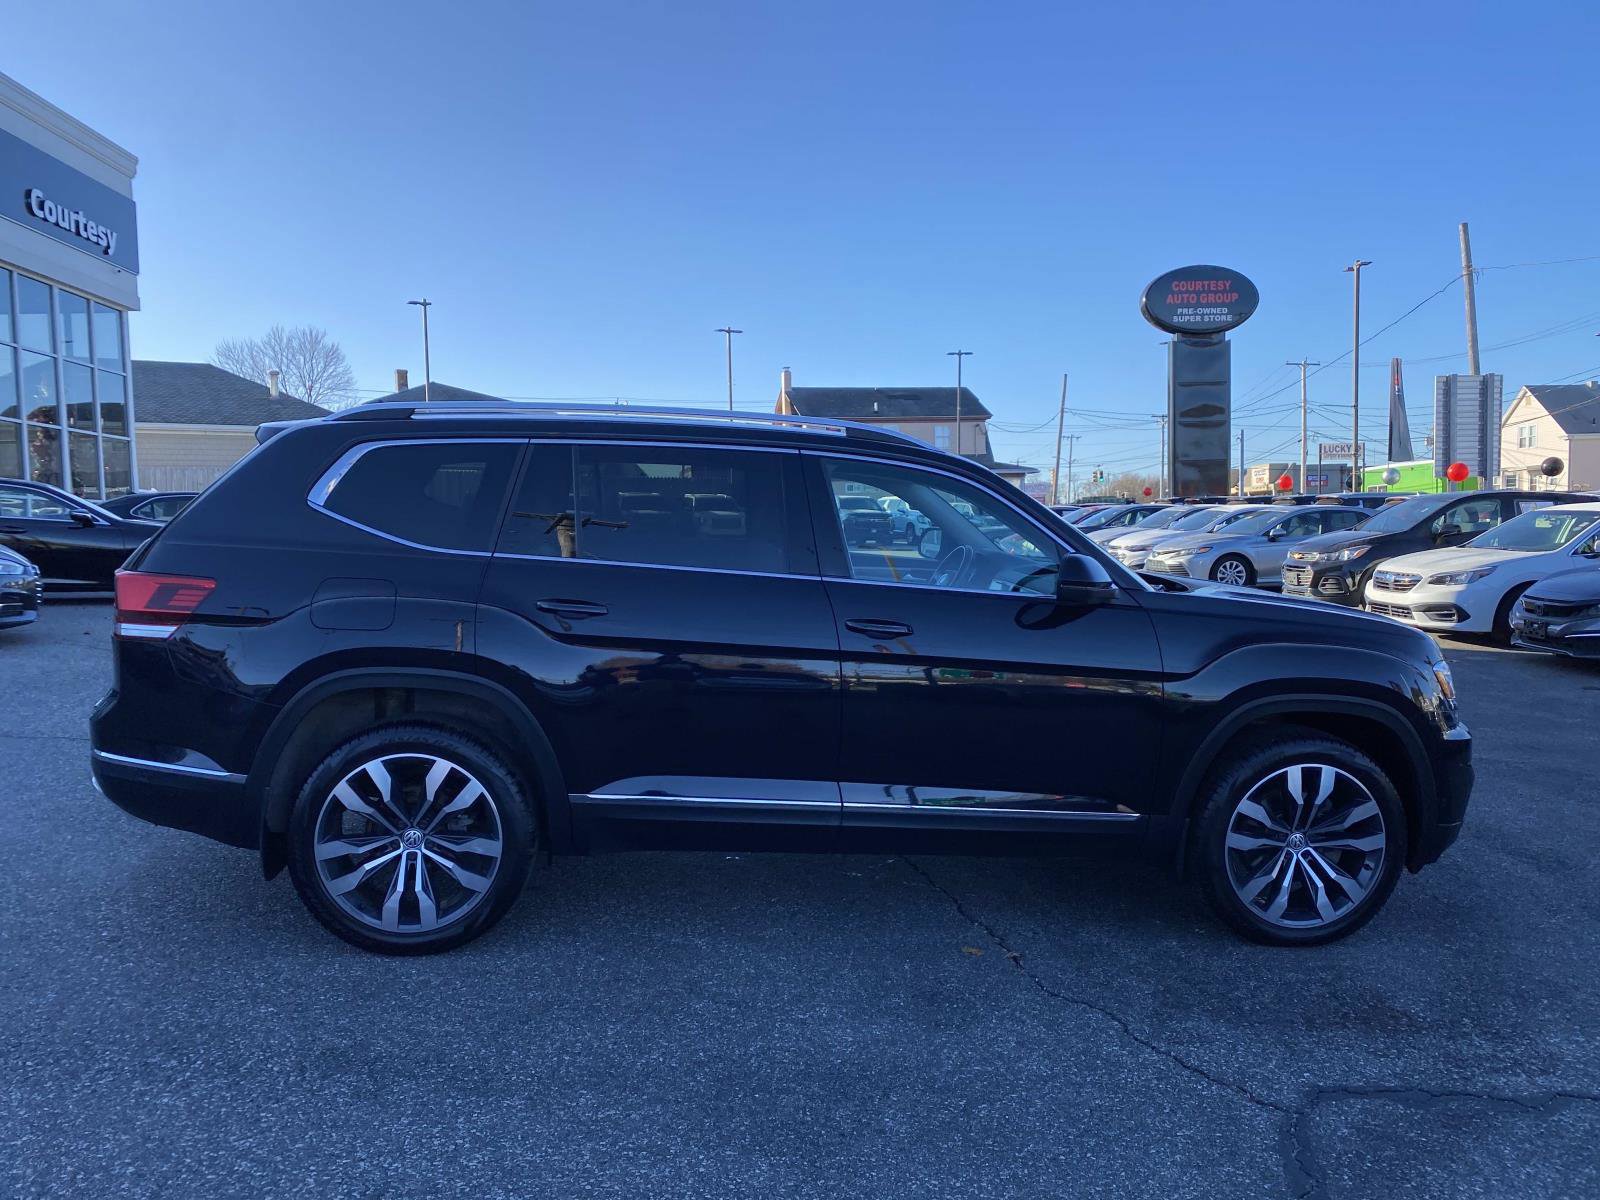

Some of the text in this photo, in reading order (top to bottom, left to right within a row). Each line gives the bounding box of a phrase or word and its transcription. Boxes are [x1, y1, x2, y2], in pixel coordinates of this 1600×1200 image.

[25, 188, 118, 256] Courtesy
[1172, 281, 1232, 291] COURTESY
[1166, 293, 1239, 304] AUTO GROUP
[1323, 444, 1352, 453] LUCKY
